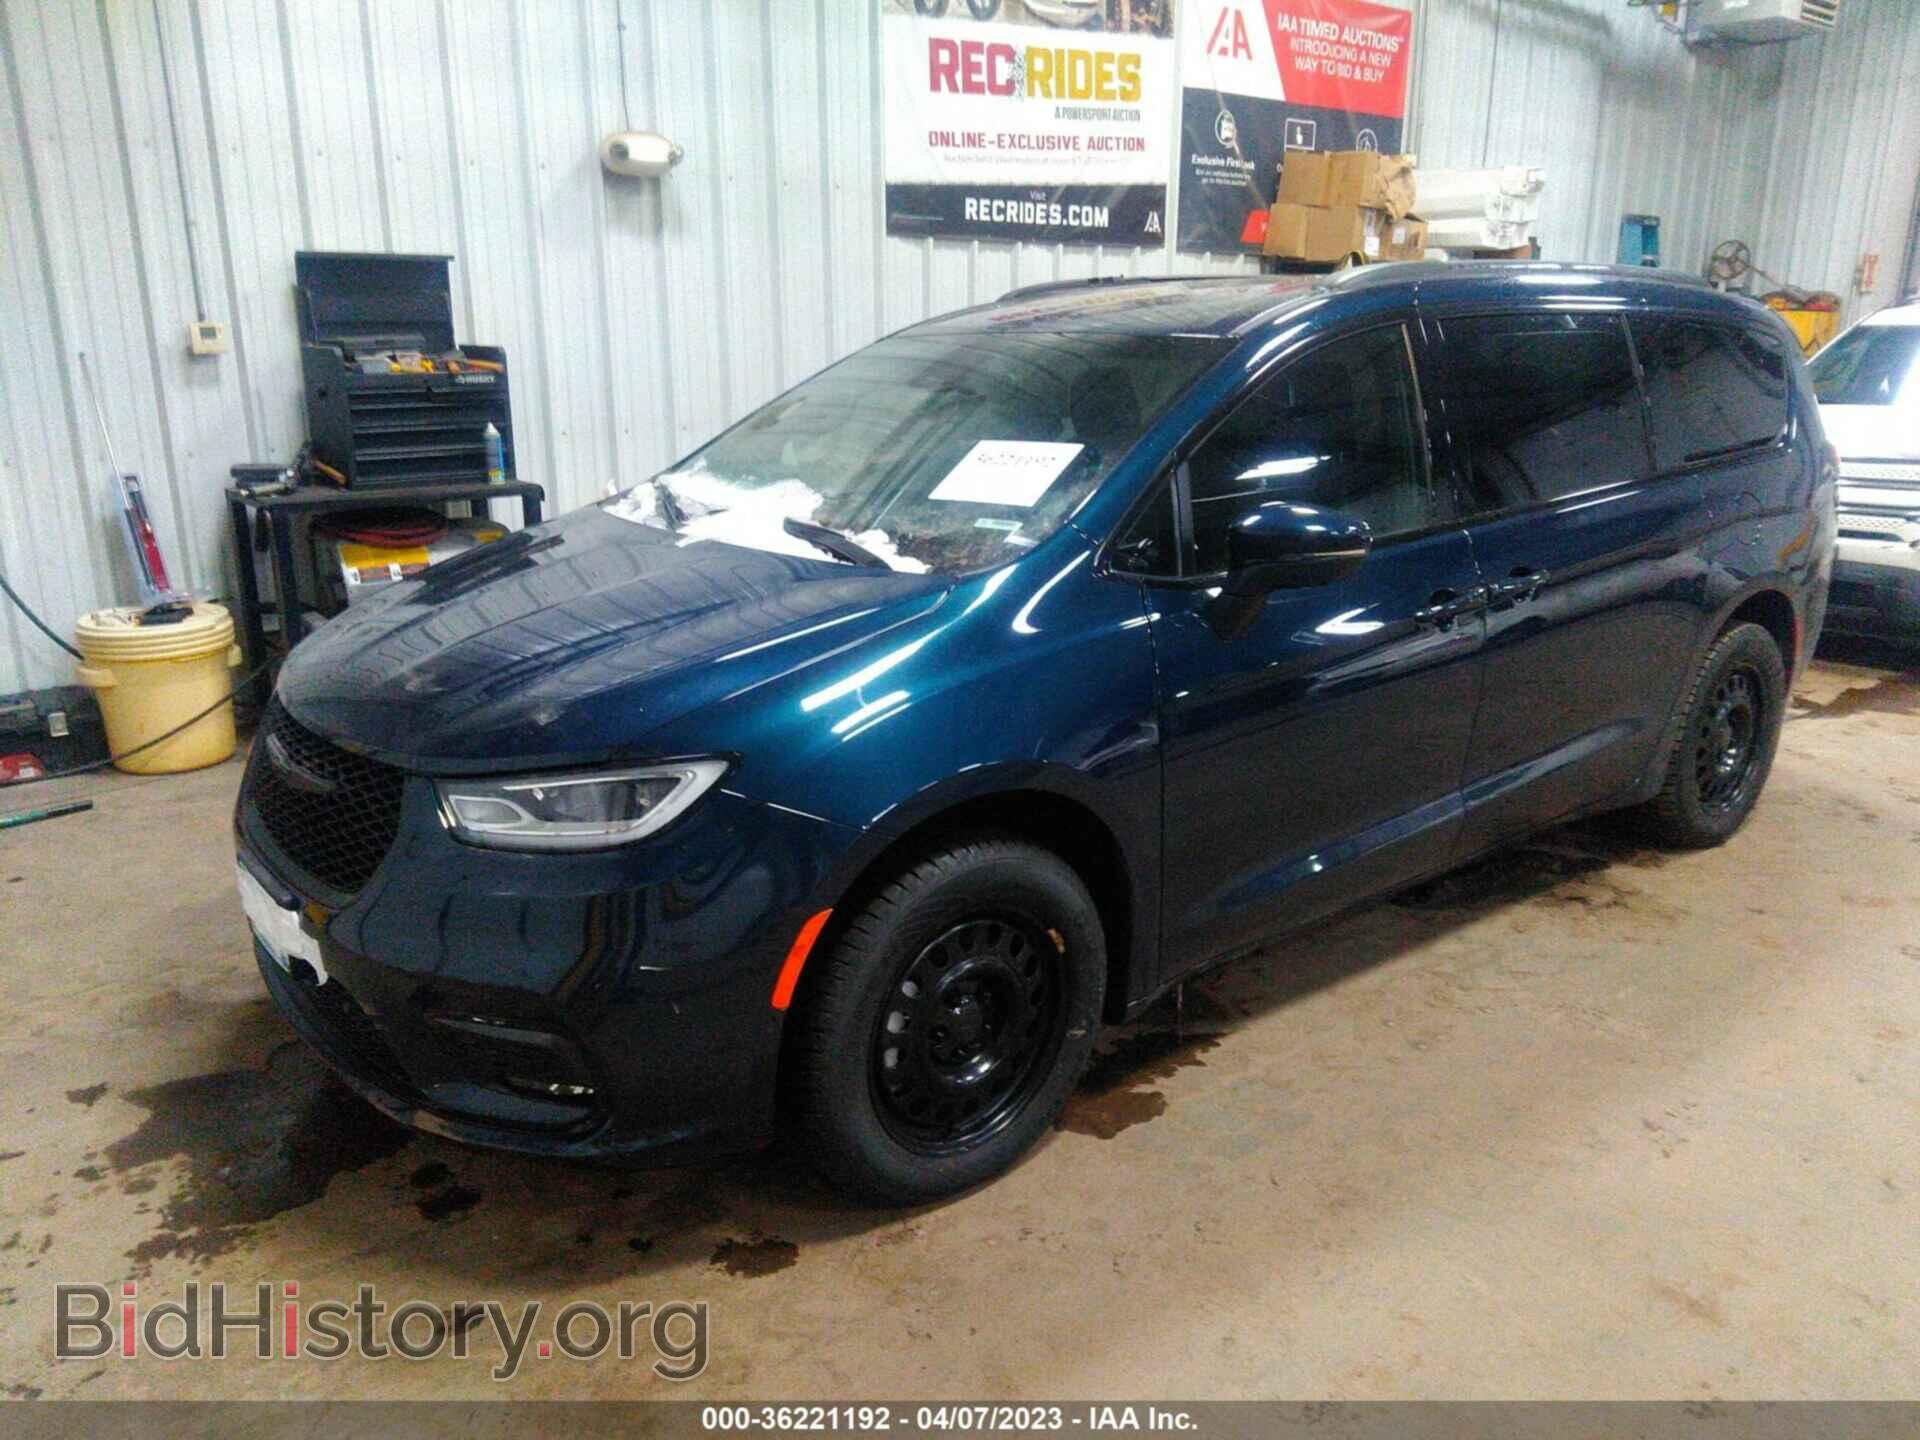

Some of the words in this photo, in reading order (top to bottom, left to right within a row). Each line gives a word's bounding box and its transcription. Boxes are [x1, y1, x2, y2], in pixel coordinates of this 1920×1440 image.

[1277, 12, 1297, 32] IAA
[1300, 18, 1339, 39] TIMED
[1290, 37, 1357, 63] INTRODUCING
[1359, 51, 1367, 64] A
[1368, 53, 1391, 68] NEW
[928, 37, 1016, 96] REC
[1026, 46, 1141, 103] RIDES
[1295, 57, 1318, 72] WAY
[1321, 60, 1336, 75] TO
[1337, 63, 1352, 78] BID
[1354, 67, 1362, 80] &
[1363, 68, 1384, 82] BUY
[1054, 106, 1061, 120] A
[928, 130, 1080, 152] ONLINE-EXCLUSIVE
[1087, 136, 1146, 152] AUCTION
[964, 197, 1109, 228] RECRIDES.COM
